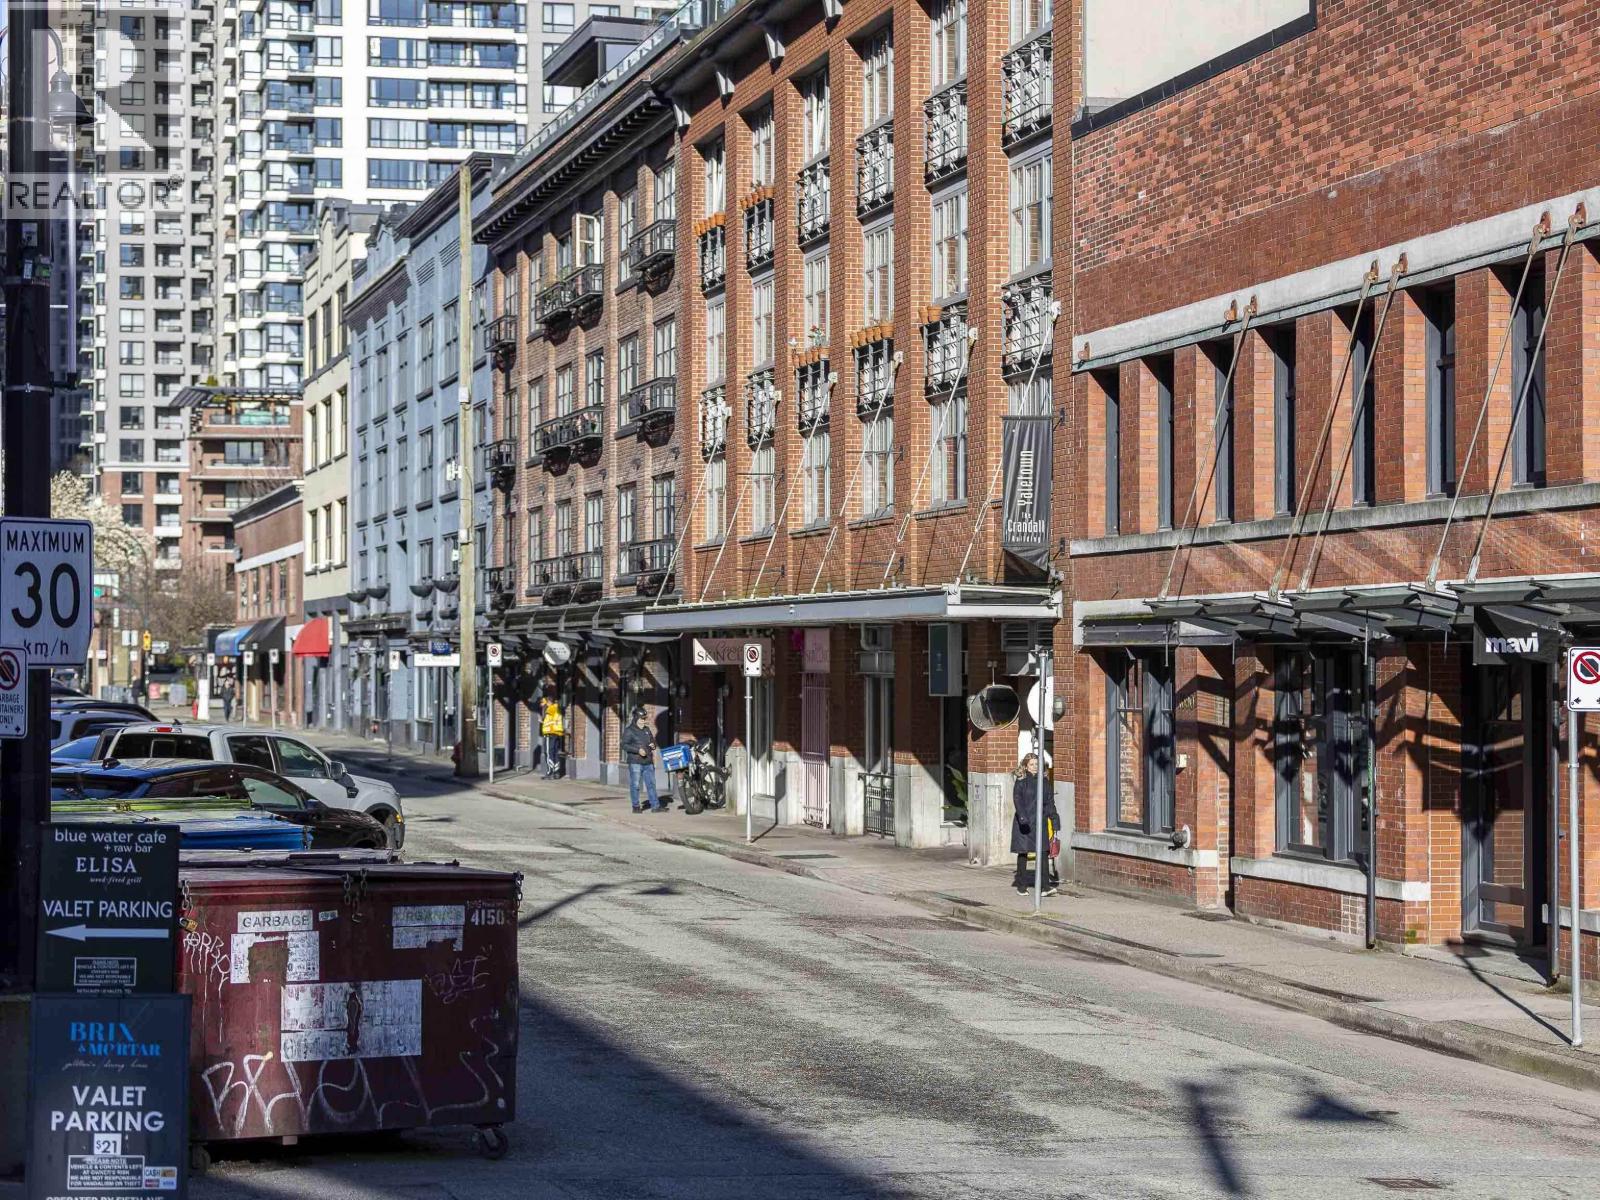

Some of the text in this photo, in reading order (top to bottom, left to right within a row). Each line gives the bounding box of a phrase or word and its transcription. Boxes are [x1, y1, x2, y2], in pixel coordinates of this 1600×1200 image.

[1017, 450, 1035, 505] Yaletown
[1007, 519, 1045, 533] Crandall
[6, 530, 84, 553] MAXIMUM
[11, 562, 81, 629] 30
[23, 637, 69, 658] km/h
[1485, 632, 1539, 654] mavi
[55, 828, 167, 843] blue water cafe
[113, 845, 133, 853] raw
[135, 843, 153, 853] bar
[76, 856, 137, 873] ELISA
[43, 900, 173, 919] VALET PARKING
[470, 909, 505, 925] 4150
[242, 915, 310, 928] GARBAGE
[70, 1021, 134, 1041] BRIX
[89, 1043, 161, 1056] MORTAR
[72, 1085, 147, 1106] VALET
[51, 1110, 165, 1132] PARKING
[96, 1140, 118, 1154] $21
